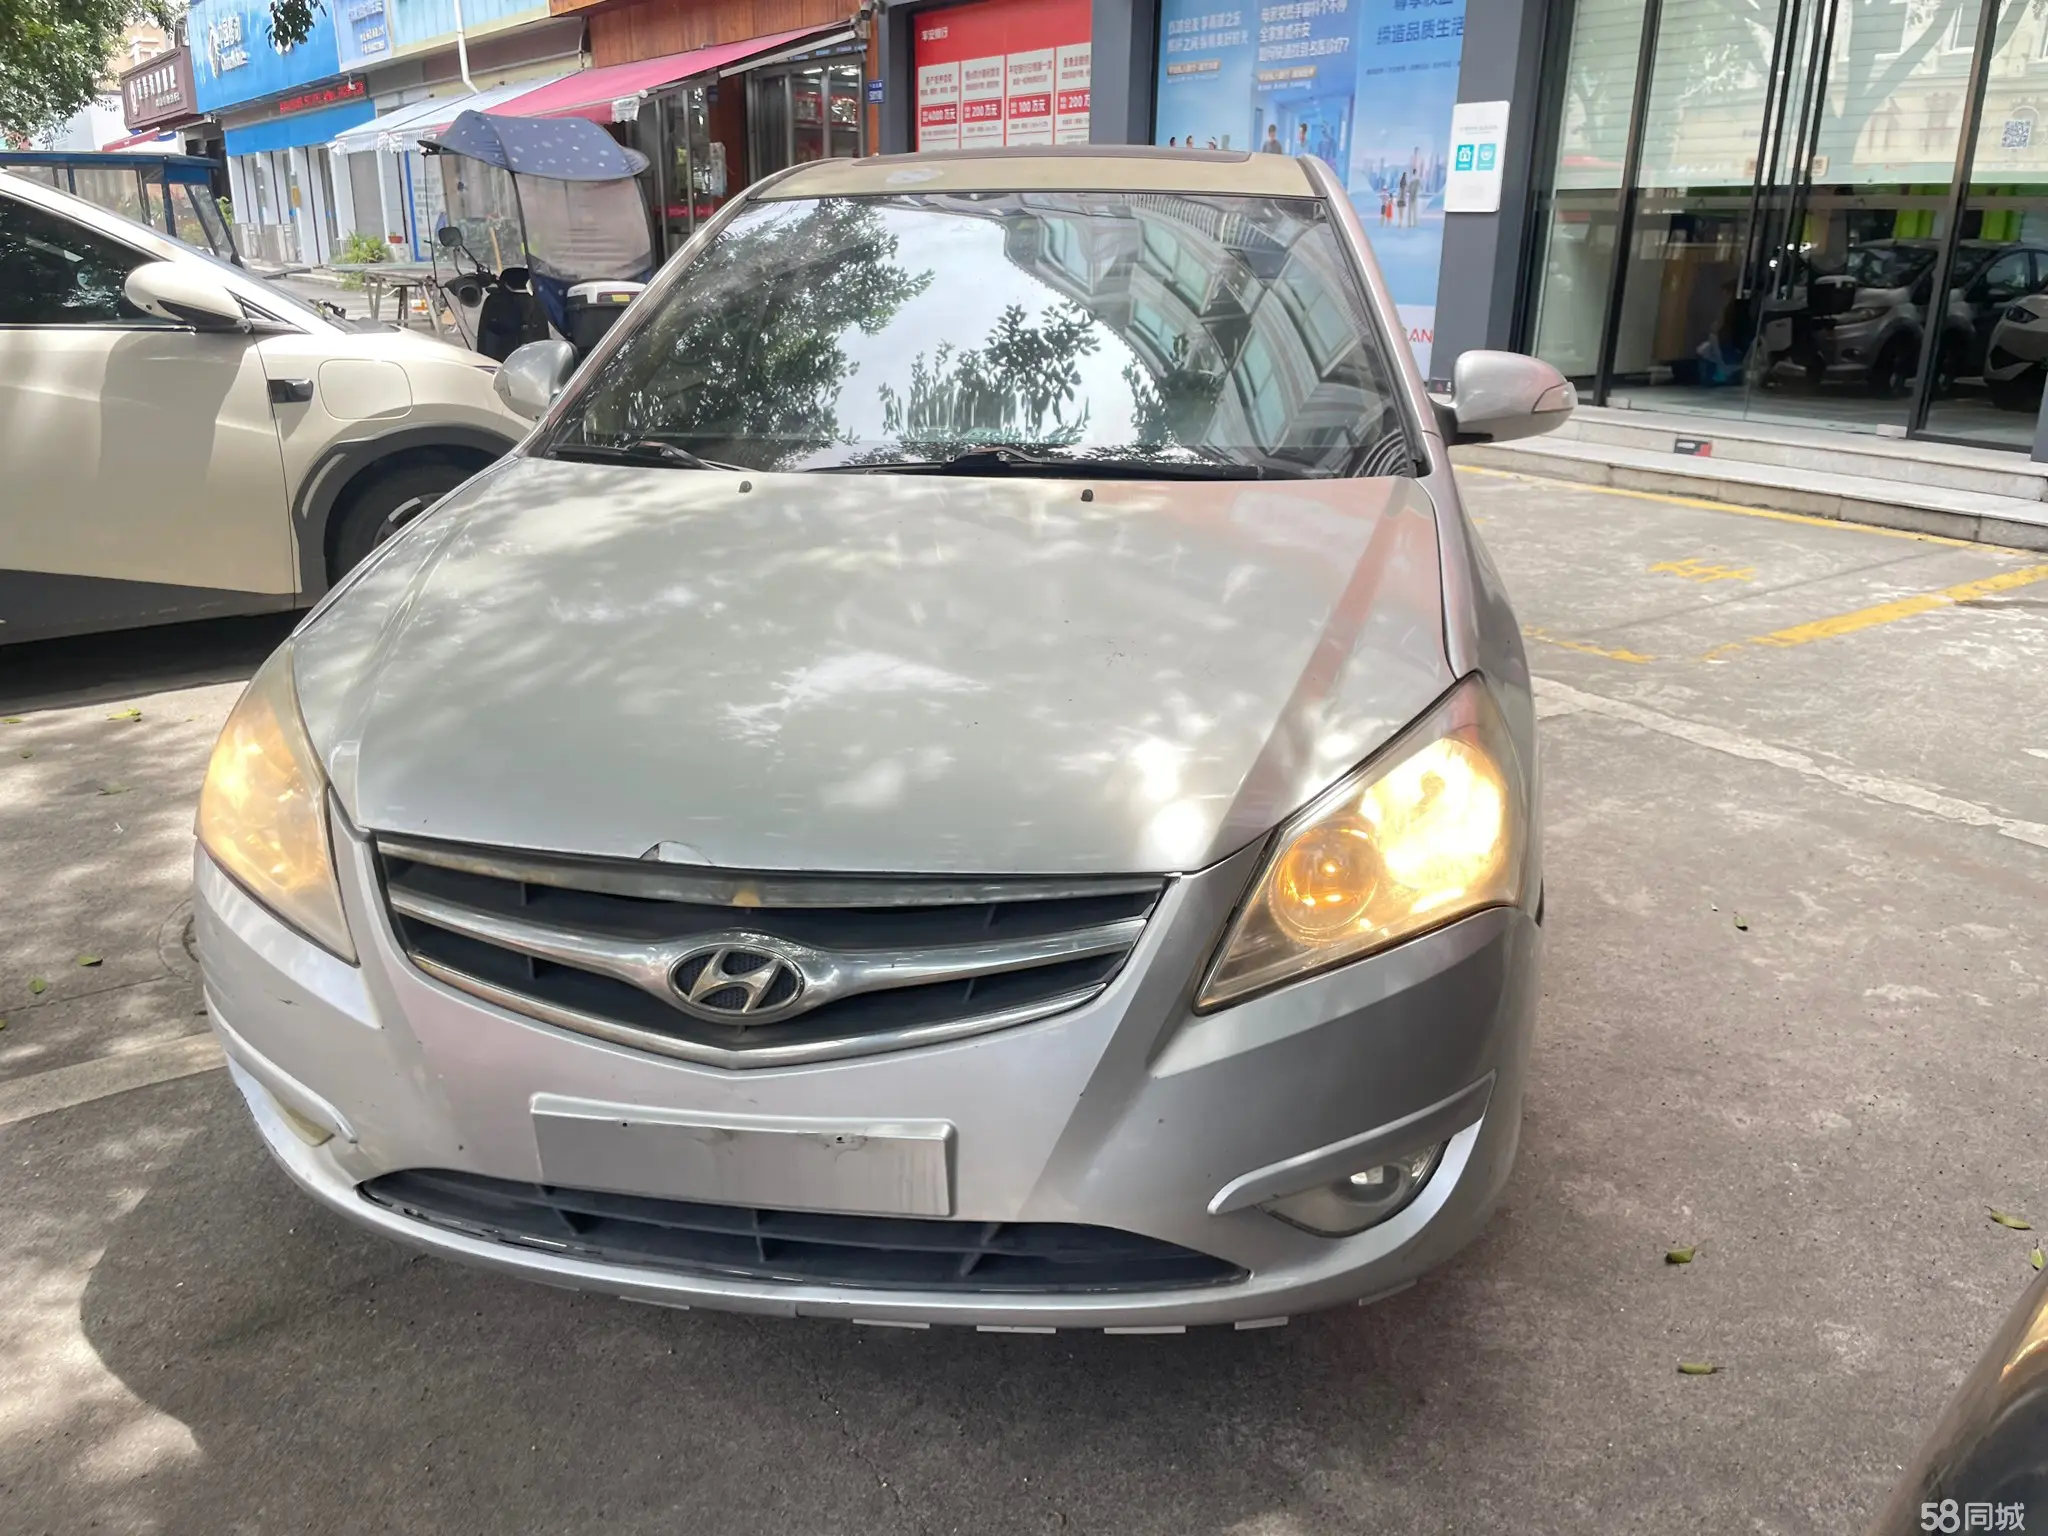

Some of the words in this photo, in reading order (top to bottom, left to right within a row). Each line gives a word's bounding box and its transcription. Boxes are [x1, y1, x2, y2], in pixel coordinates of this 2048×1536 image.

[921, 26, 949, 41] 平安银行
[1376, 16, 1465, 45] 缔造品质生活
